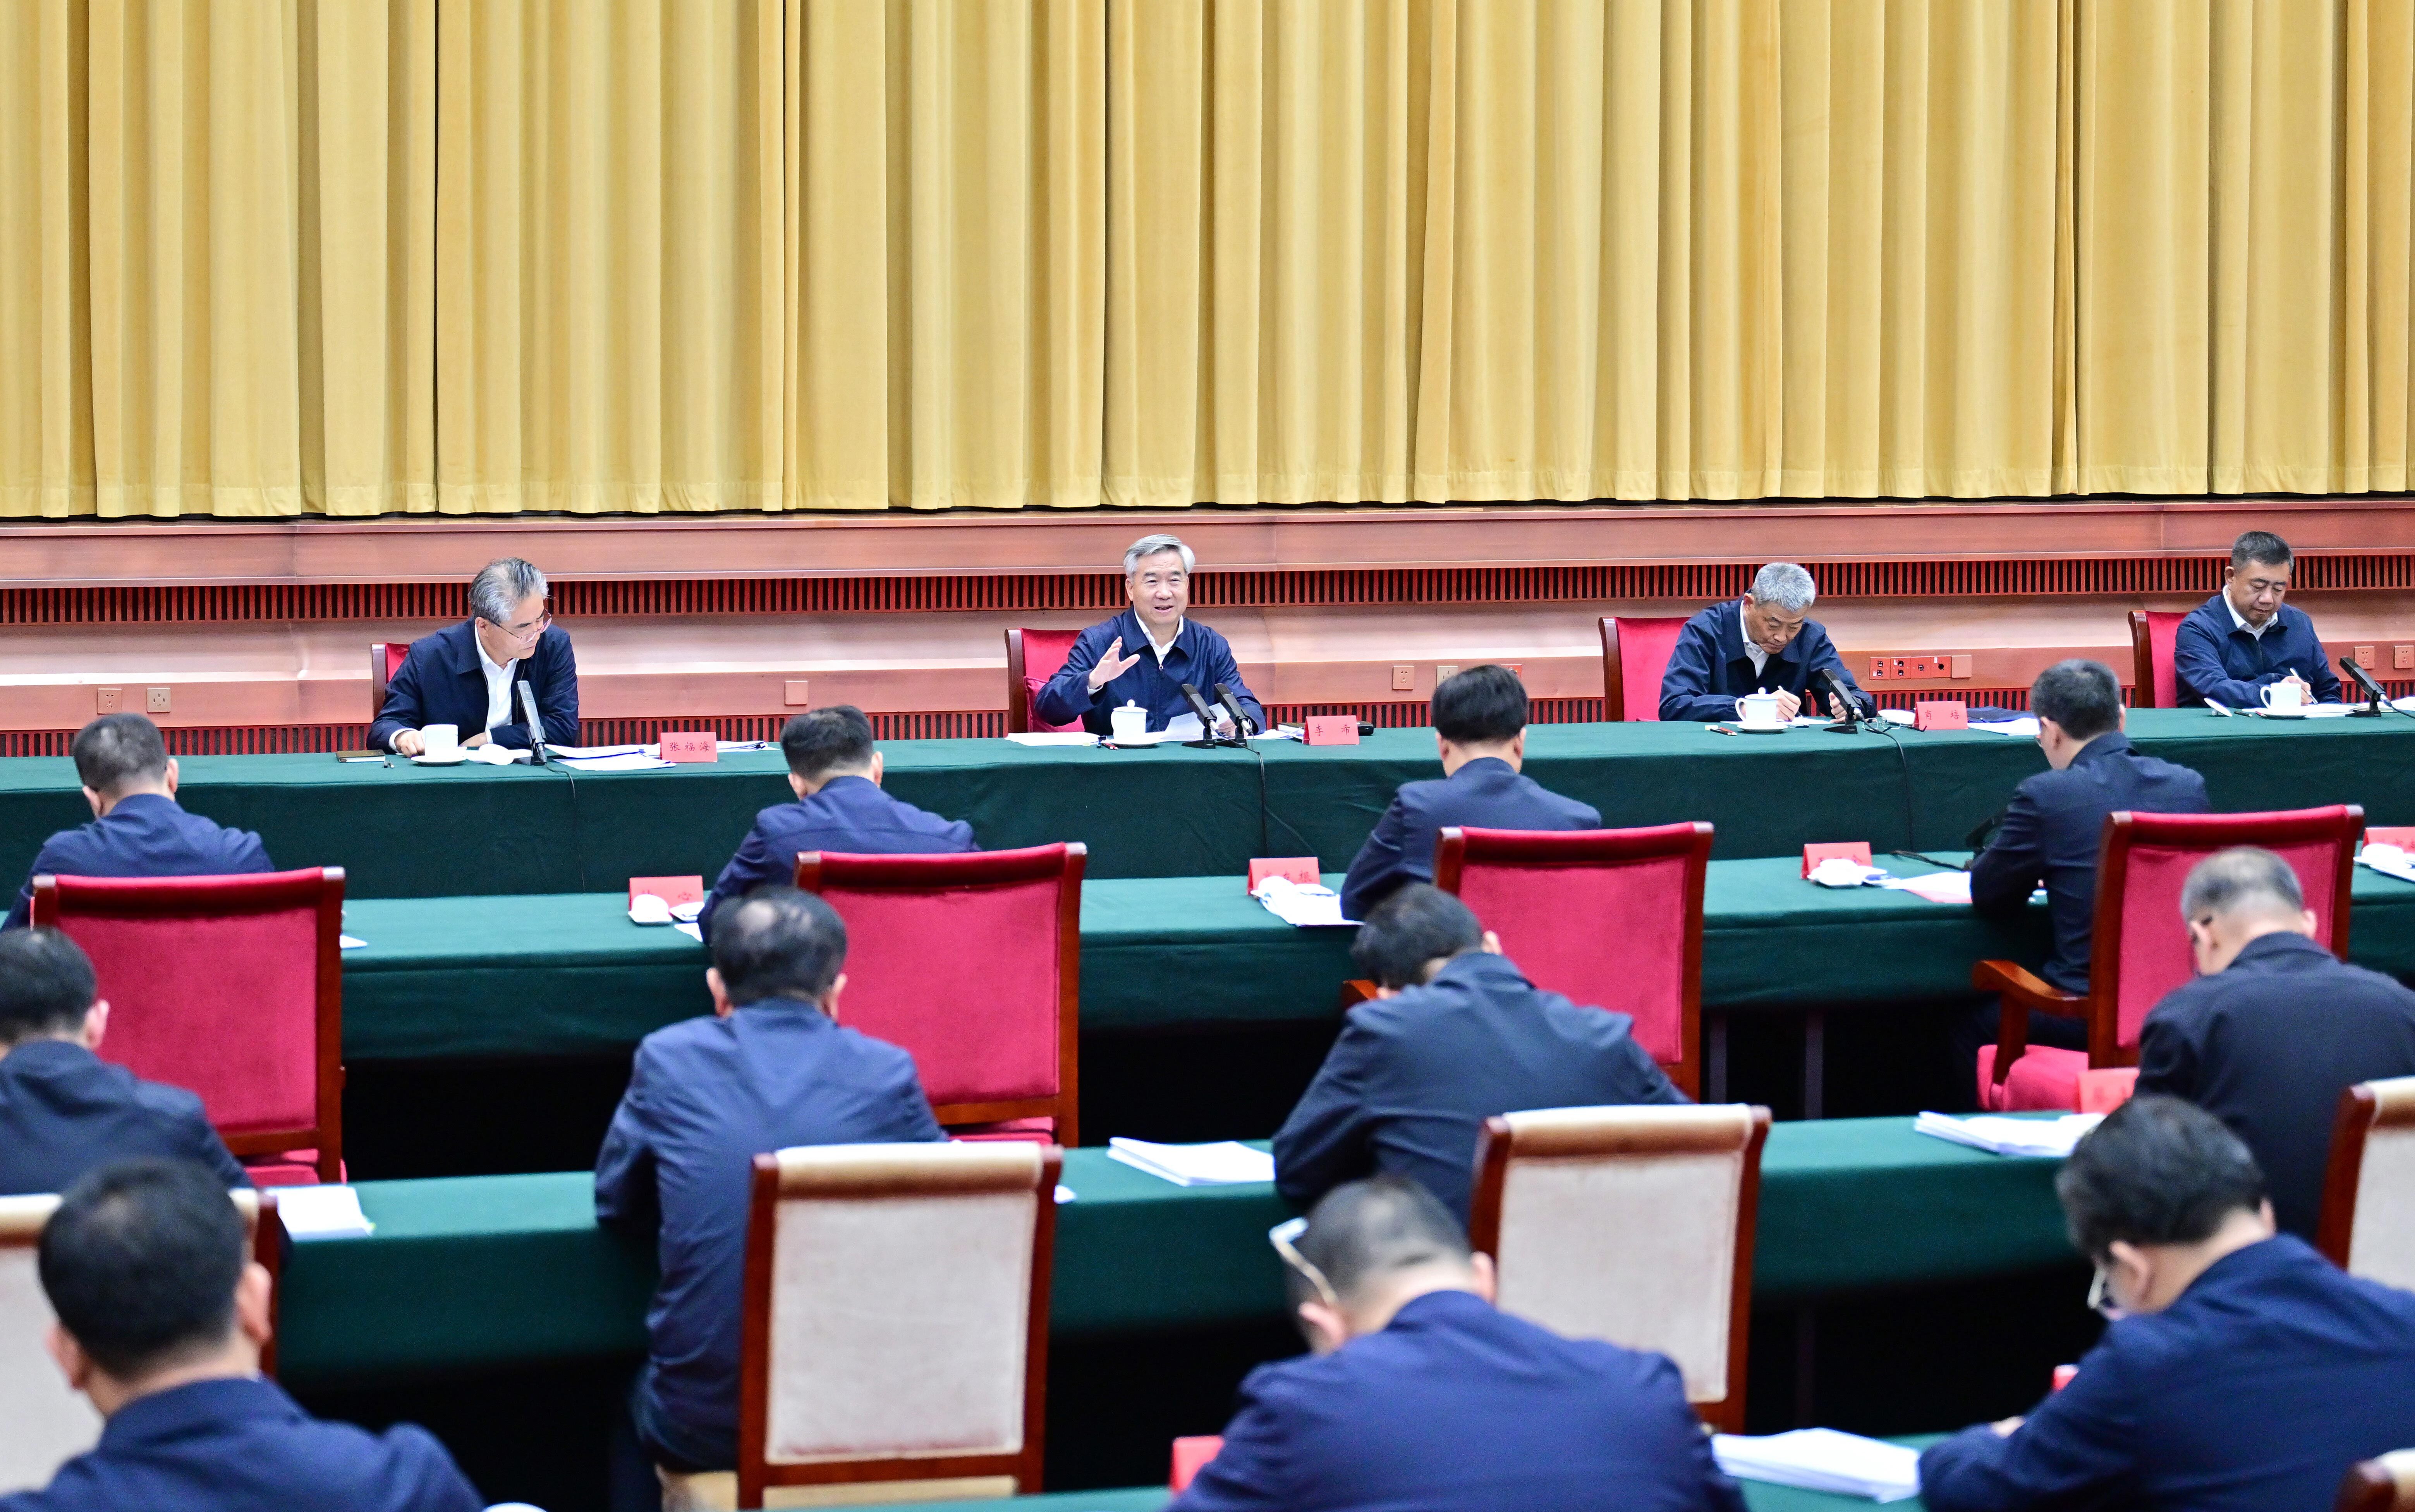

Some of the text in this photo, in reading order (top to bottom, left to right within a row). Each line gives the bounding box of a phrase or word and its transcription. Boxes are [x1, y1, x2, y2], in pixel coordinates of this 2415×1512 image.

[1925, 709, 1960, 720] 肖培
[1314, 724, 1350, 736] 李希
[669, 741, 711, 752] 张福海
